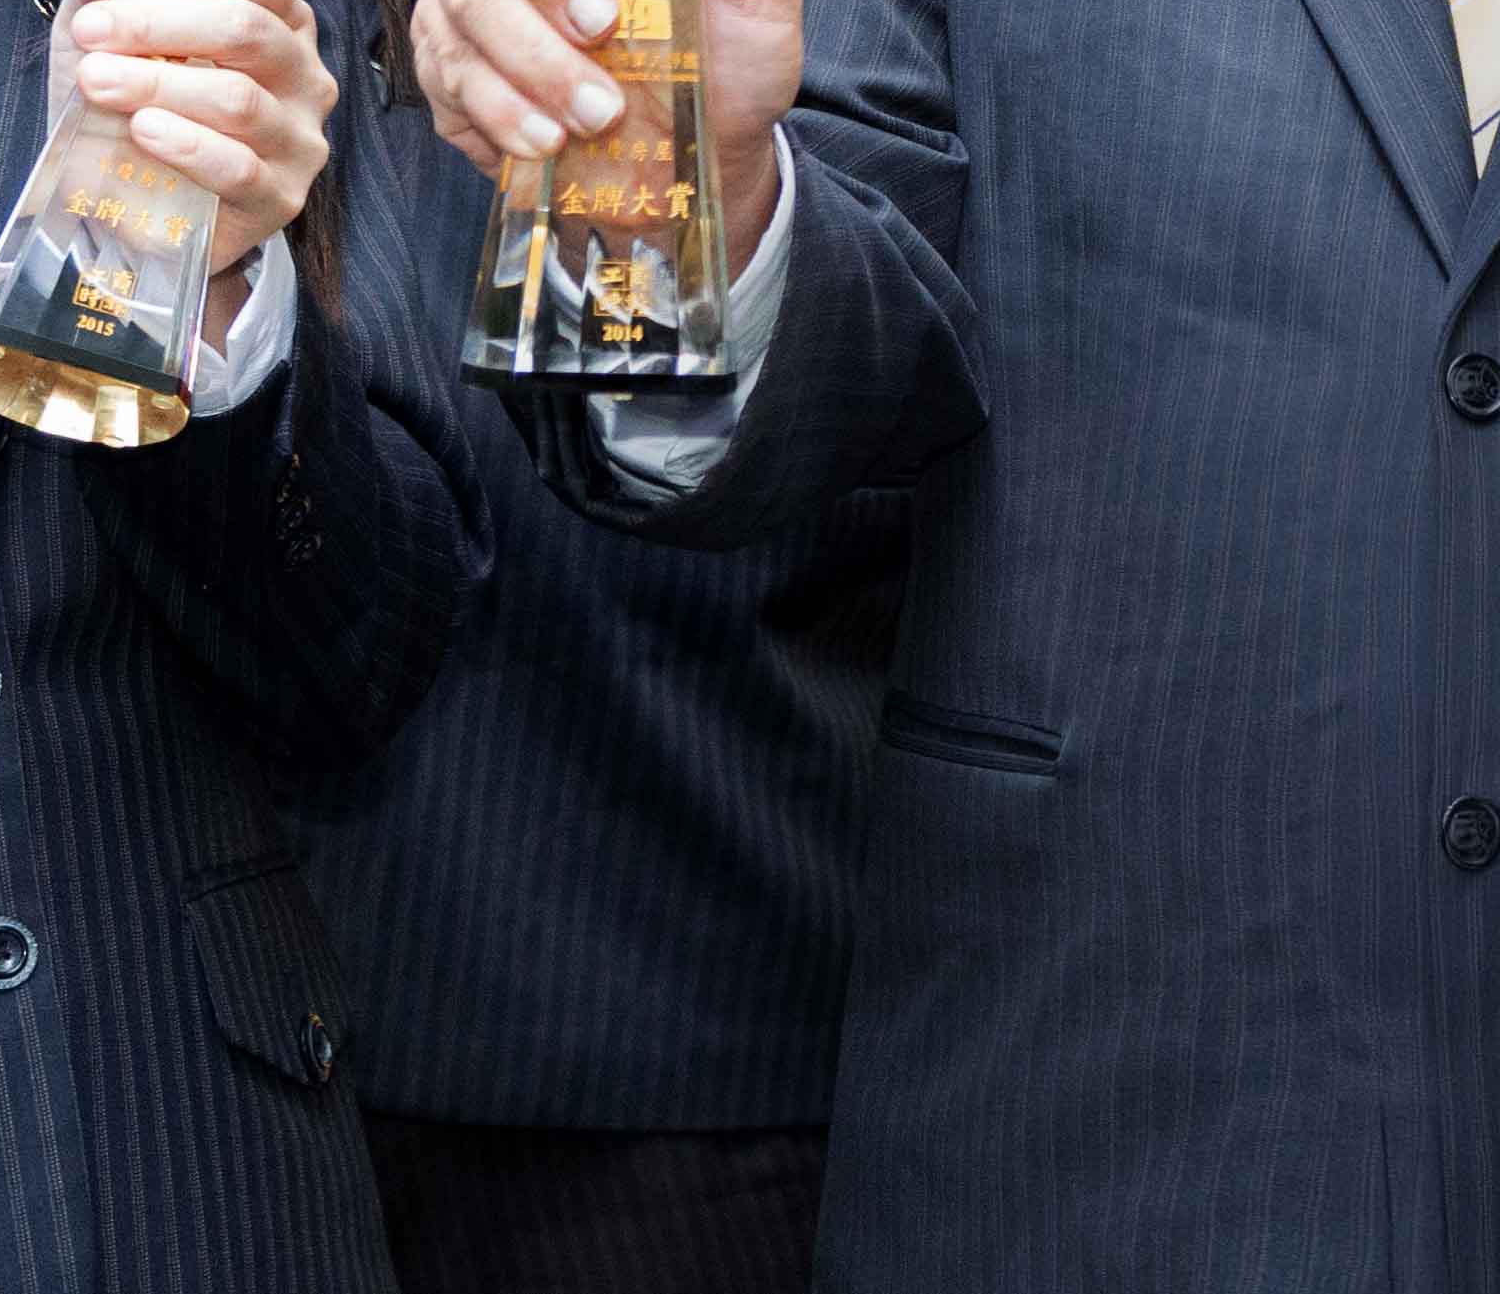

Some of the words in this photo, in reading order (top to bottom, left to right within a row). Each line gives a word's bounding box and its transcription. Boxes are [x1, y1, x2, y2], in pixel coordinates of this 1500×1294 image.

[558, 181, 697, 220] 金牌大賞
[76, 314, 117, 337] 2015
[602, 324, 644, 342] 2014
